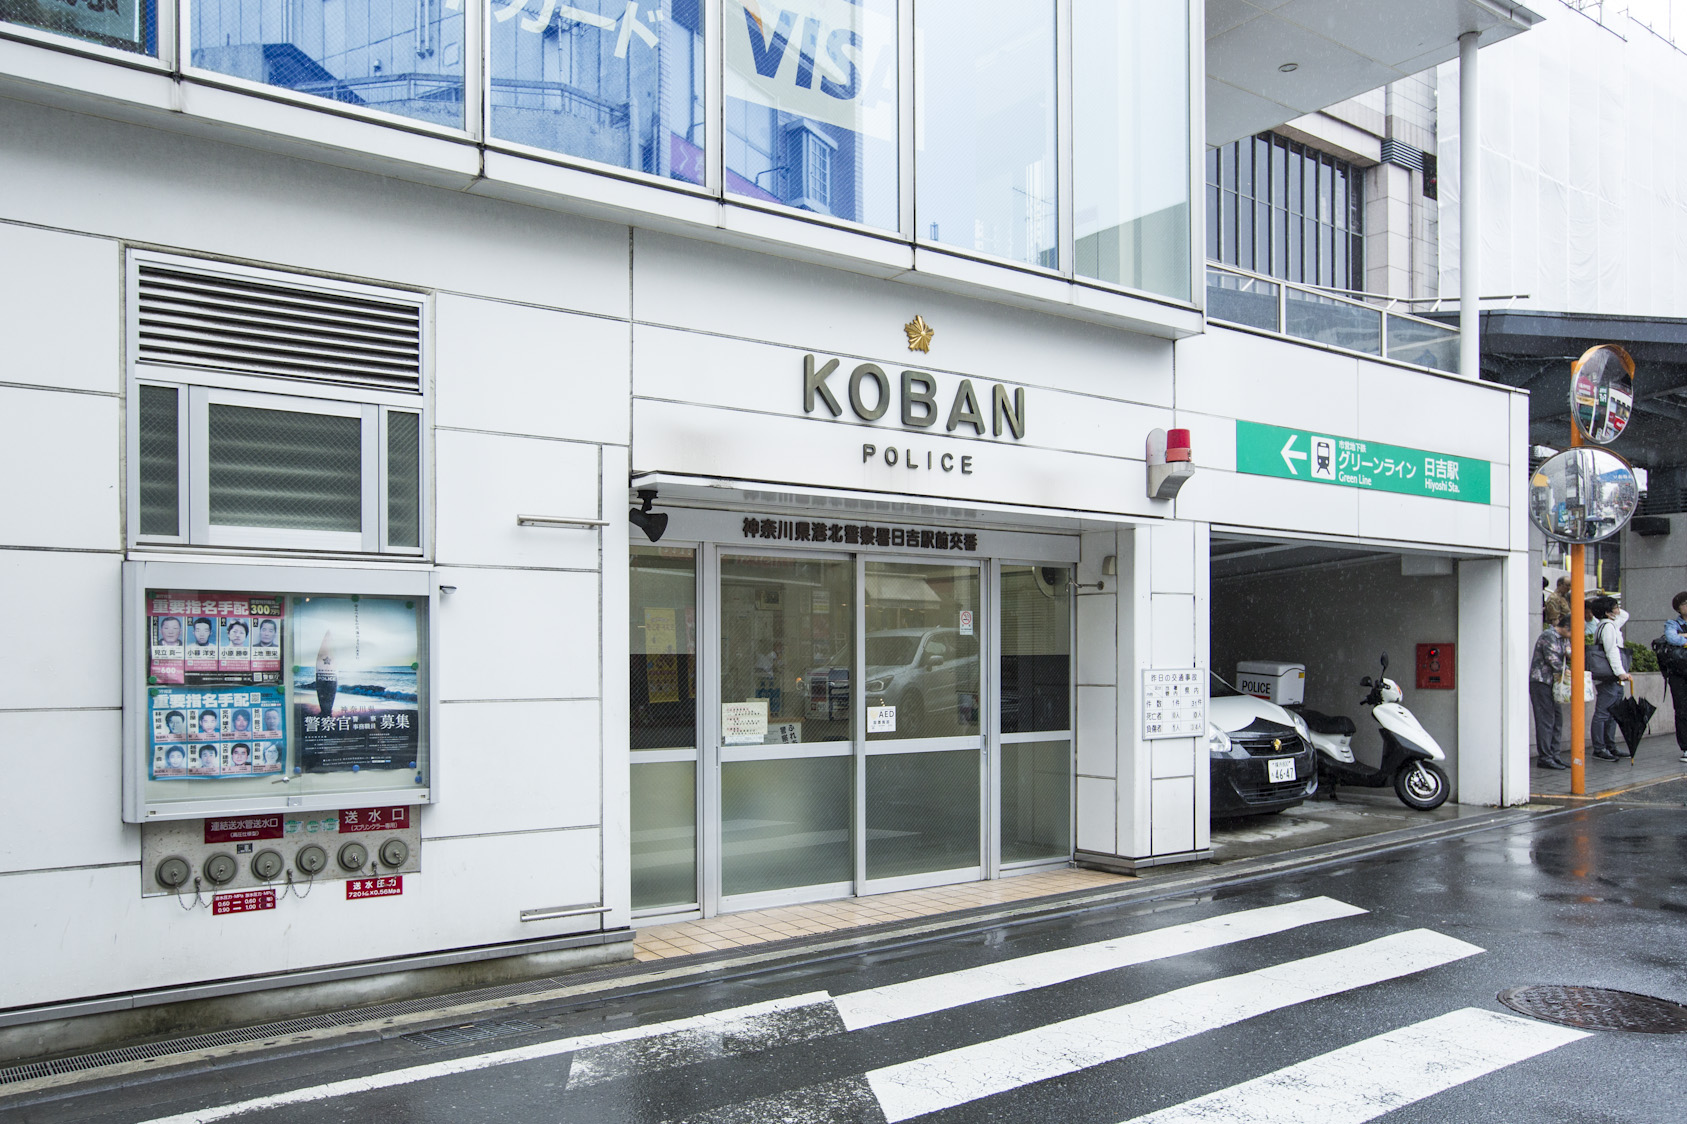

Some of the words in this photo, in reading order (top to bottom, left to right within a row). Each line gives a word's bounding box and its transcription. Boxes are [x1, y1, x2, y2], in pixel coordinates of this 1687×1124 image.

[742, 5, 893, 109] VISA
[803, 353, 1025, 440] KOBAN
[1338, 440, 1367, 453] 市営地下鉄
[862, 443, 973, 475] POLICE
[1338, 452, 1417, 479] グリーンライン
[1424, 457, 1459, 481] 日吉駅
[1338, 471, 1358, 484] Green
[1358, 474, 1372, 486] Line
[1424, 478, 1447, 492] Hiyoshi
[1448, 481, 1460, 493] Sta.
[742, 517, 978, 551] 神奈川県港北警察署日吉駅前交番
[152, 599, 249, 616] 重要指名手配
[1151, 673, 1197, 682] 昨日の交通事故
[1242, 680, 1271, 694] POLICE
[153, 693, 249, 708] 重要指名手配
[380, 714, 410, 729] 募集
[878, 710, 895, 718] AED
[304, 715, 351, 732] 警察官
[344, 808, 405, 824] 送水口
[210, 818, 279, 832] 連結送水管送水口
